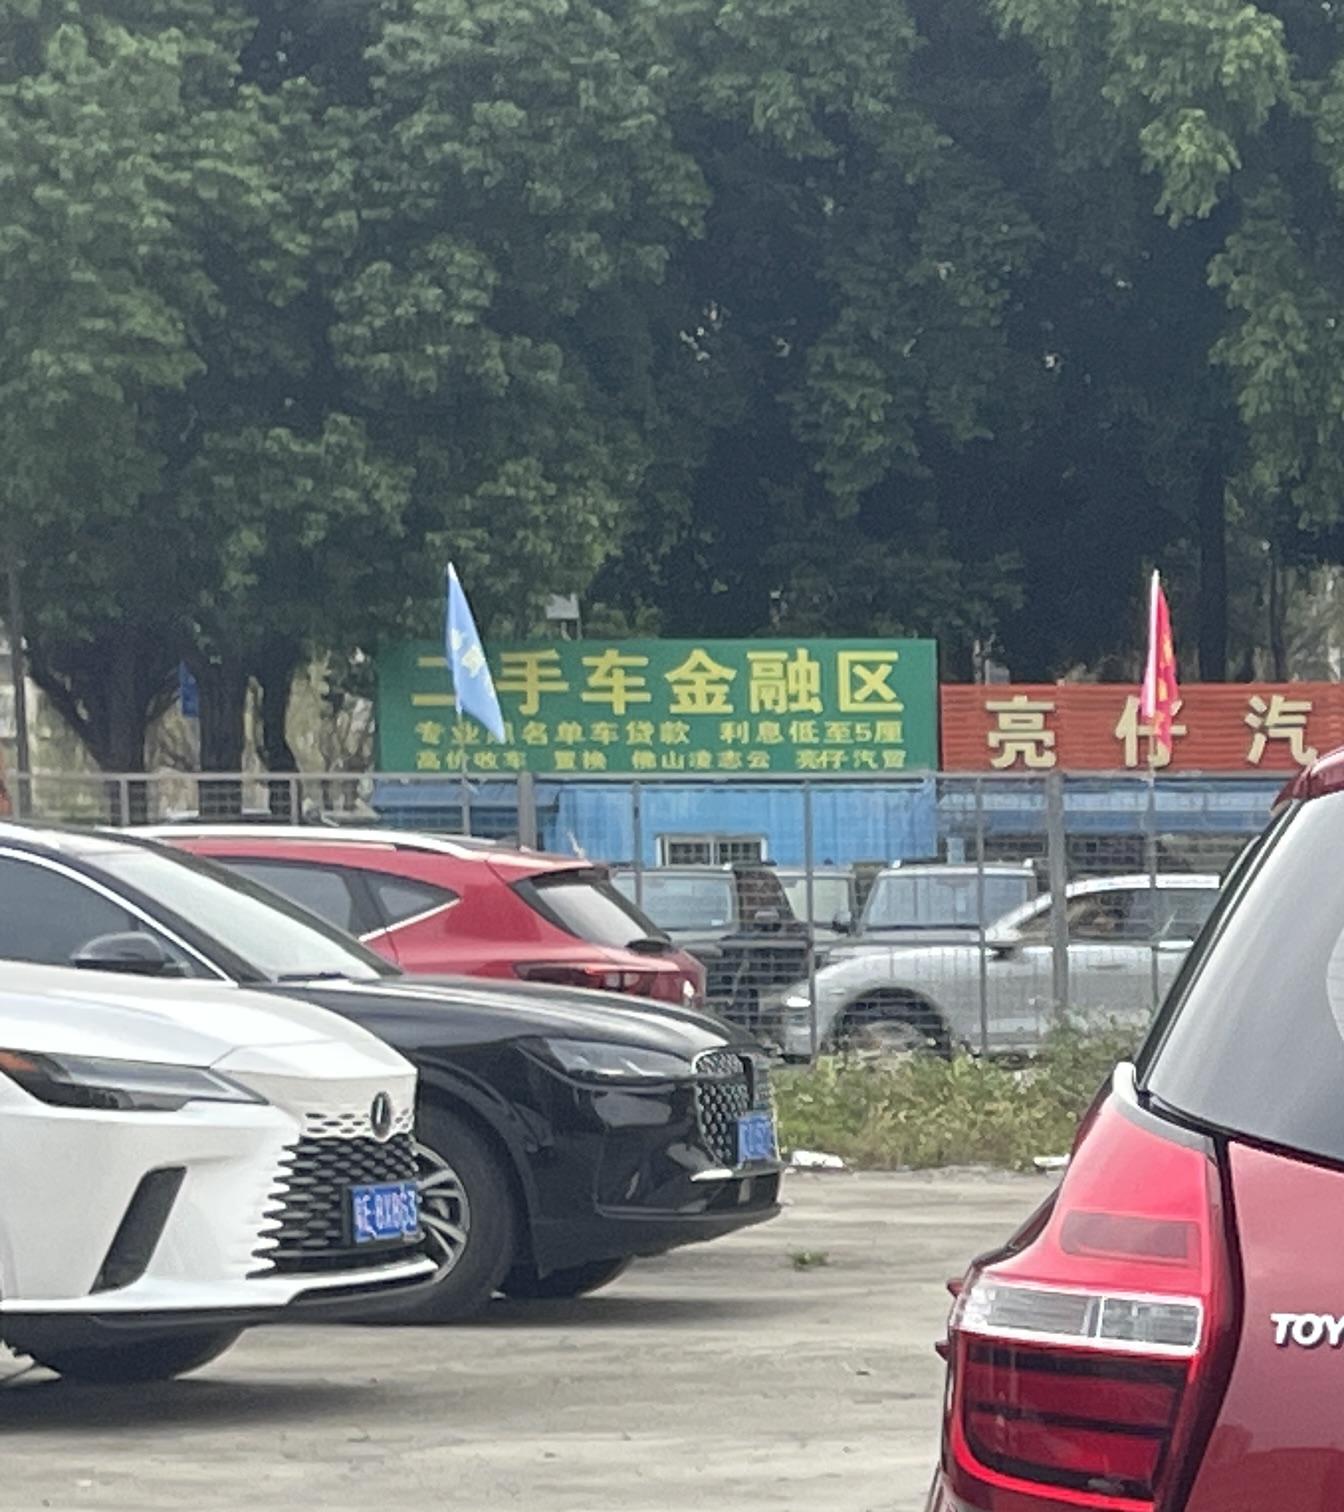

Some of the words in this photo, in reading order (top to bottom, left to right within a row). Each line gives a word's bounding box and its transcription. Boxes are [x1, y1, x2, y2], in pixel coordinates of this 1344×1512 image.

[411, 646, 904, 715] 二手车金融区
